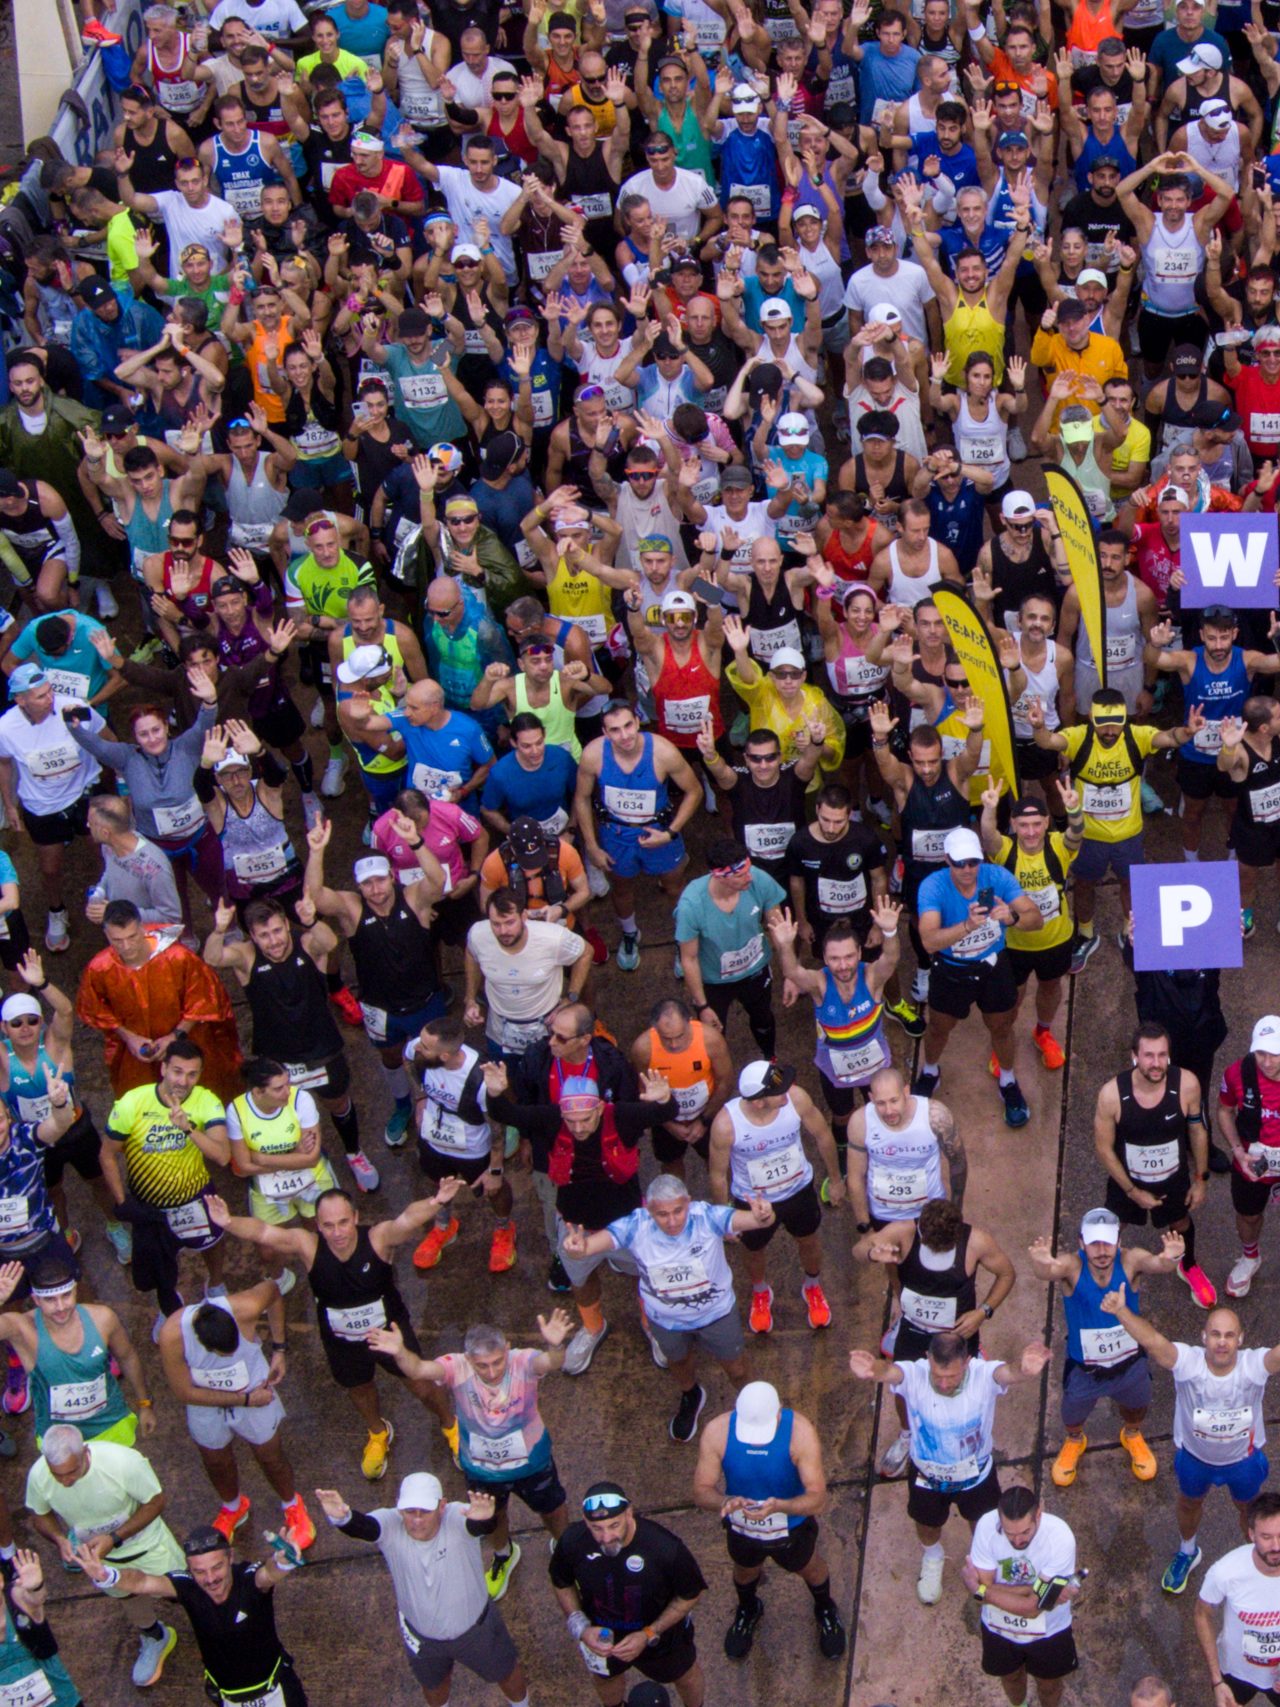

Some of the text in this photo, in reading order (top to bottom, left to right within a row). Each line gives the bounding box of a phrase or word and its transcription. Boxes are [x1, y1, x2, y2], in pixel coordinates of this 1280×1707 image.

[1164, 261, 1189, 271] 2347
[1176, 355, 1197, 366] ciele
[412, 386, 437, 397] 1132
[971, 448, 994, 459] 1264
[1190, 533, 1268, 586] W
[760, 639, 786, 652] 2144
[1105, 647, 1126, 657] 945
[857, 667, 883, 679] 1920
[675, 711, 702, 721] 1262
[44, 759, 67, 770] 393
[1096, 760, 1122, 770] PACE
[1088, 767, 1131, 779] RUNNER
[617, 800, 643, 810] 1634
[1090, 799, 1124, 809] 28961
[171, 815, 191, 828] 229
[757, 837, 785, 848] 1802
[924, 842, 944, 851] 153
[247, 862, 275, 873] 1551
[1019, 871, 1044, 881] PACE
[1020, 877, 1053, 889] UNNER
[830, 892, 857, 902] 2096
[1159, 885, 1212, 946] P
[958, 930, 995, 947] 27235
[847, 1057, 869, 1069] 619
[1142, 1158, 1163, 1169] 701
[766, 1166, 788, 1179] 213
[274, 1178, 304, 1193] 1441
[889, 1184, 912, 1195] 293
[171, 1216, 194, 1227] 442
[666, 1272, 689, 1283] 207
[915, 1307, 939, 1320] 517
[345, 1319, 370, 1330] 488
[1099, 1341, 1121, 1353] 611
[208, 1378, 233, 1389] 570
[65, 1394, 96, 1408] 4435
[1211, 1423, 1234, 1433] 587
[485, 1449, 509, 1459] 332
